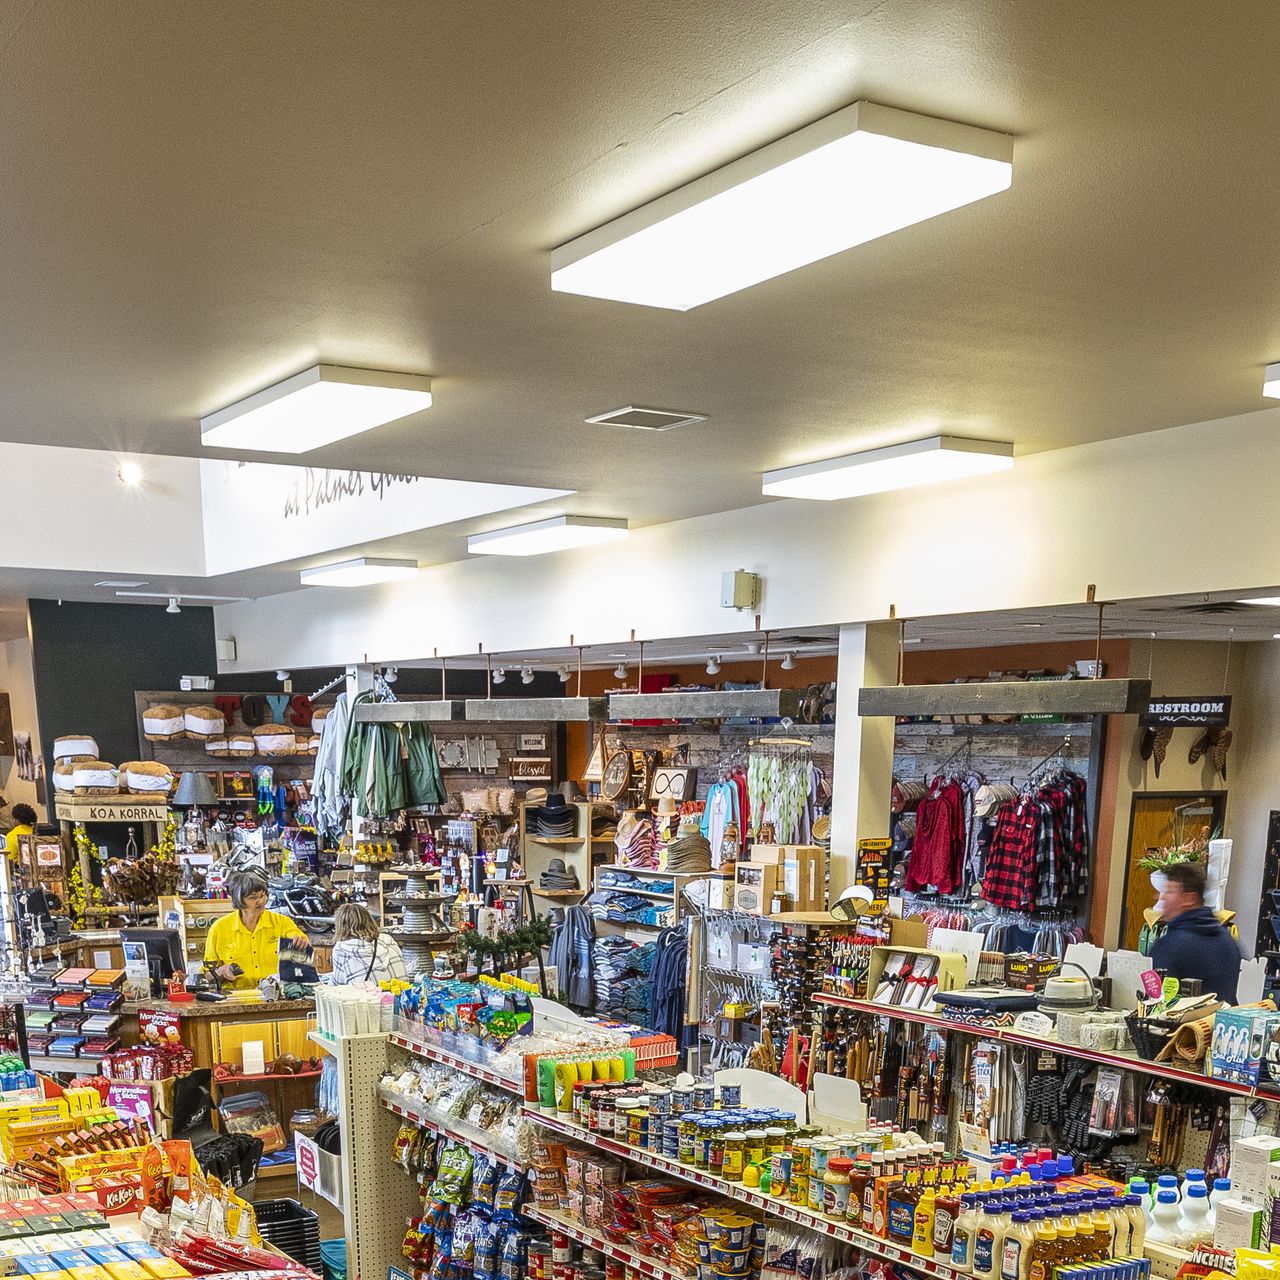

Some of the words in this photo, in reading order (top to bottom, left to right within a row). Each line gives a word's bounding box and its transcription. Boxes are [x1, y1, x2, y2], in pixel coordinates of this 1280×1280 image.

[215, 694, 313, 727] TOYS
[1148, 702, 1224, 714] RESTROOM
[90, 807, 116, 820] KOA
[119, 807, 163, 820] KORRAL
